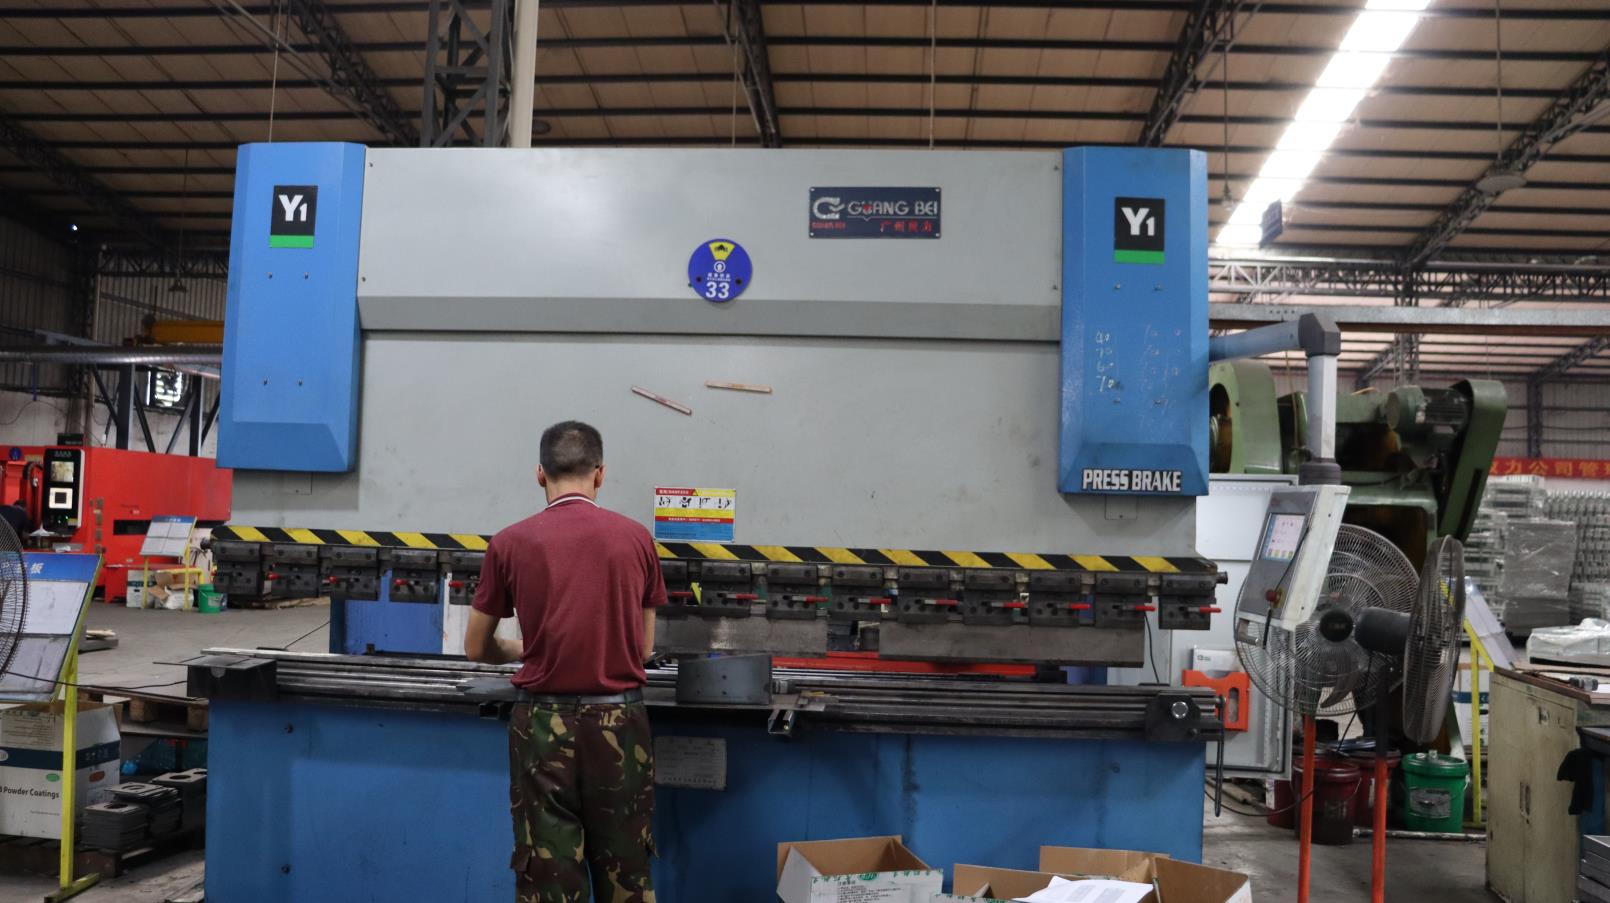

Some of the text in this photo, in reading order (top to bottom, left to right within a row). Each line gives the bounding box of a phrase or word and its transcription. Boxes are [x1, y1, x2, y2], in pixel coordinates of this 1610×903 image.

[278, 194, 308, 222] Y1
[848, 200, 938, 216] GUANG BEI
[1121, 206, 1155, 236] Y1
[705, 281, 730, 299] 33
[1082, 469, 1182, 492] PRESS BRAKE
[3, 786, 29, 796] Powder
[29, 788, 60, 800] Coatings
